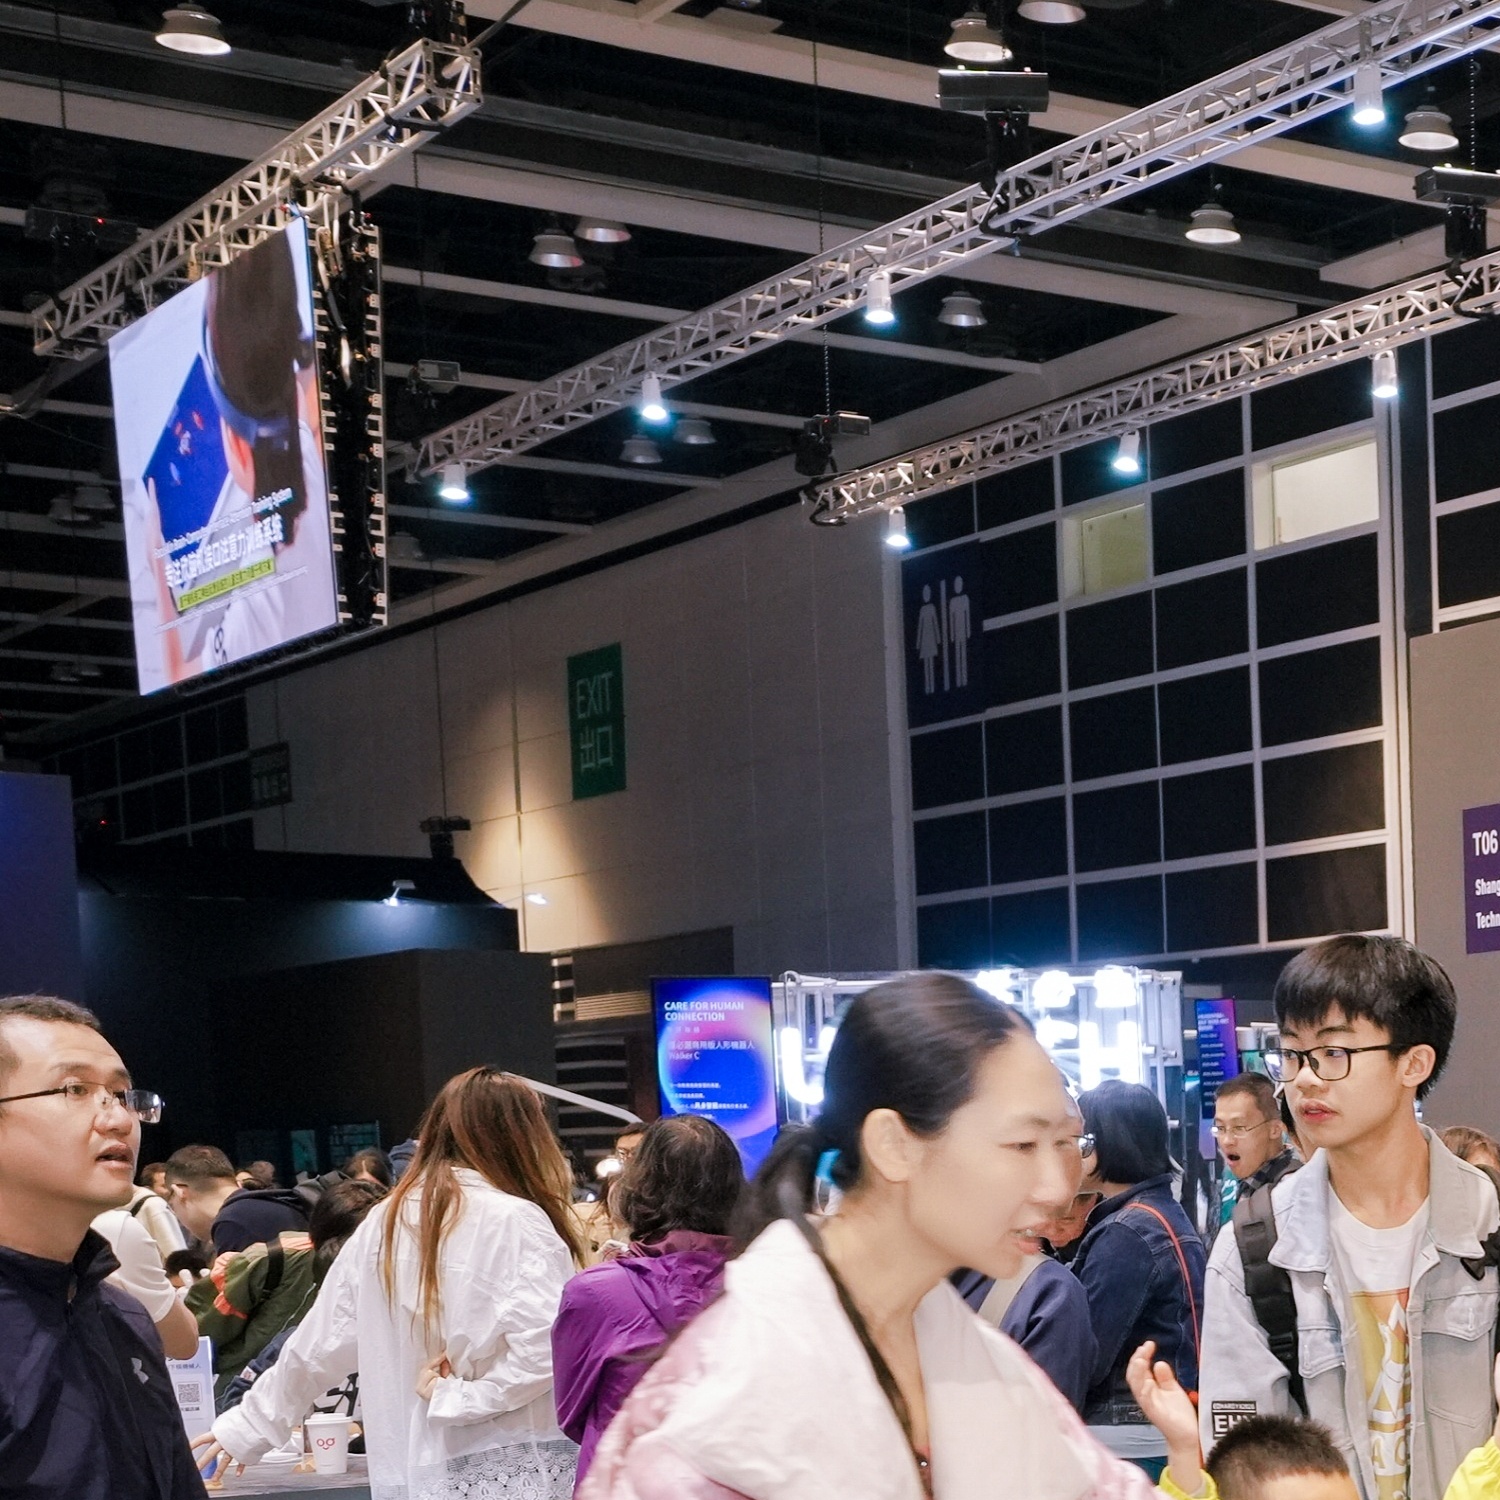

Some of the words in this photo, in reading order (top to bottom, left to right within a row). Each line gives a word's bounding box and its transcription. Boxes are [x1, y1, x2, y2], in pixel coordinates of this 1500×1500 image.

[576, 671, 614, 719] EXIT
[580, 725, 614, 775] 出口
[1472, 829, 1499, 856] T06
[664, 1001, 689, 1011] CARE
[690, 1001, 709, 1011] FOR
[710, 1001, 745, 1011] HUMAN
[665, 1012, 725, 1022] CONNECTION
